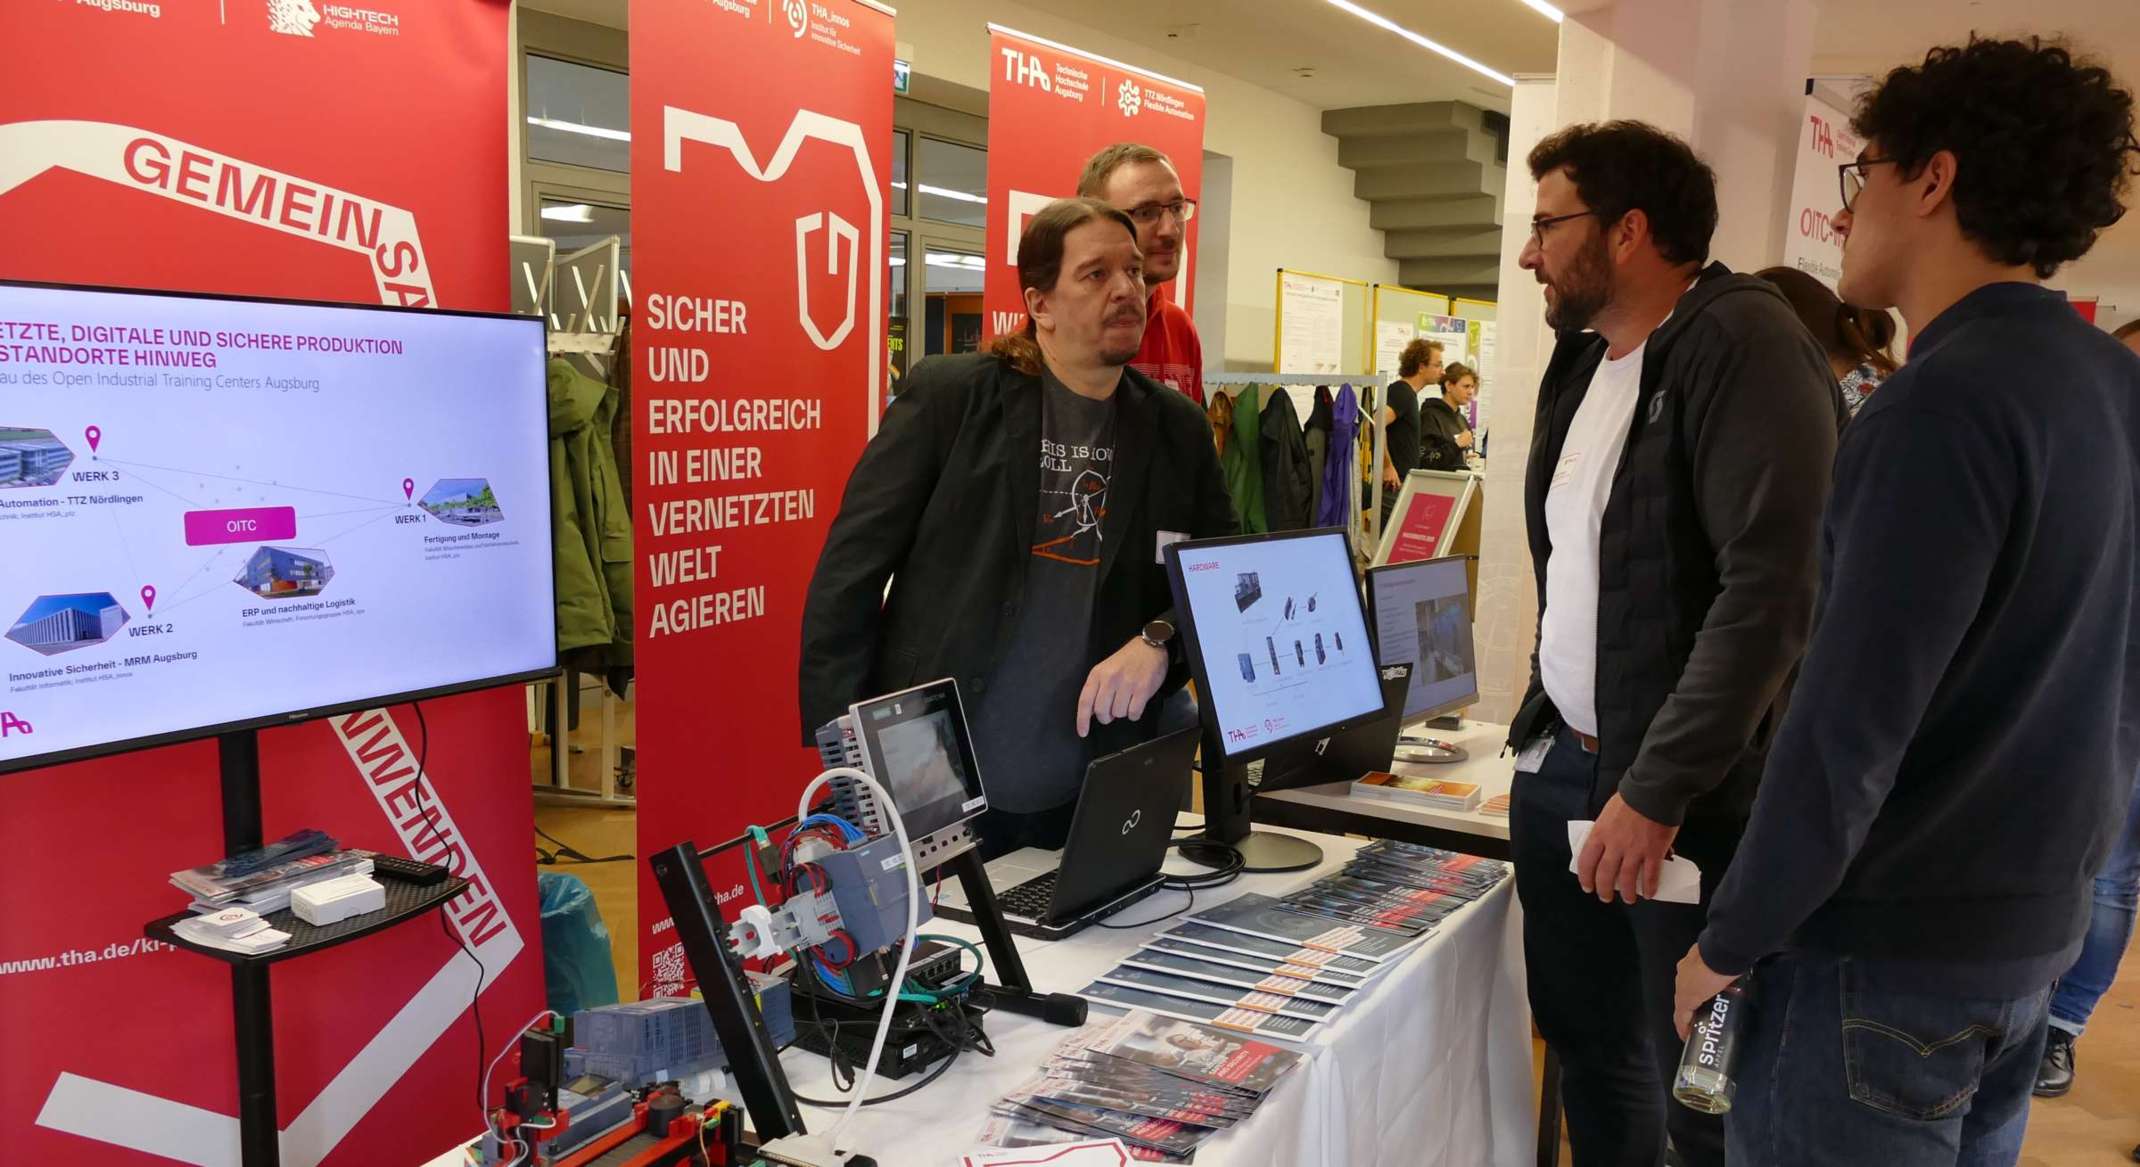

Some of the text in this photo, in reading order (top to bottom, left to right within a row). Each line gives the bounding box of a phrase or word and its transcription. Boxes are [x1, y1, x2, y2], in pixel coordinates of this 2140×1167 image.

[323, 4, 399, 26] HIGHTECH
[325, 16, 399, 36] Agenda Bayern
[1001, 47, 1051, 92] THA
[647, 293, 748, 335] SICHER
[992, 310, 1025, 336] WI
[71, 325, 164, 345] DIGITALE
[169, 329, 212, 347] UND
[216, 332, 293, 350] SICHERE
[297, 336, 403, 355] PRODUKTION
[0, 345, 217, 368] STANDORTE HINWEG
[648, 346, 710, 383] UND
[22, 370, 48, 386] des
[52, 371, 93, 388] Open
[97, 372, 158, 388] Industrial
[163, 373, 212, 391] Training
[215, 375, 261, 389] Centers
[265, 376, 320, 393] Augsburg
[649, 399, 822, 434] ERFOLGREICH
[649, 447, 763, 486] IN EINER
[1041, 455, 1072, 472] OLL
[72, 471, 120, 482] WERK 3
[67, 496, 88, 505] TTZ
[89, 494, 144, 505] Nördlingen
[394, 514, 421, 524] WERK
[648, 488, 815, 537] VERNETZTEN
[226, 518, 257, 533] OITC
[424, 532, 500, 544] Fertigung und Montage
[649, 545, 722, 588] WELT
[242, 598, 356, 617] ERP und nachhaltige Logistik
[649, 585, 766, 639] AGIEREN
[128, 623, 174, 637] WERK 2
[9, 668, 64, 683] Innovative
[65, 660, 116, 675] Sicherheit
[124, 655, 151, 667] MRM
[153, 650, 198, 664] Augsburg
[1700, 994, 1730, 1066] spritzer
